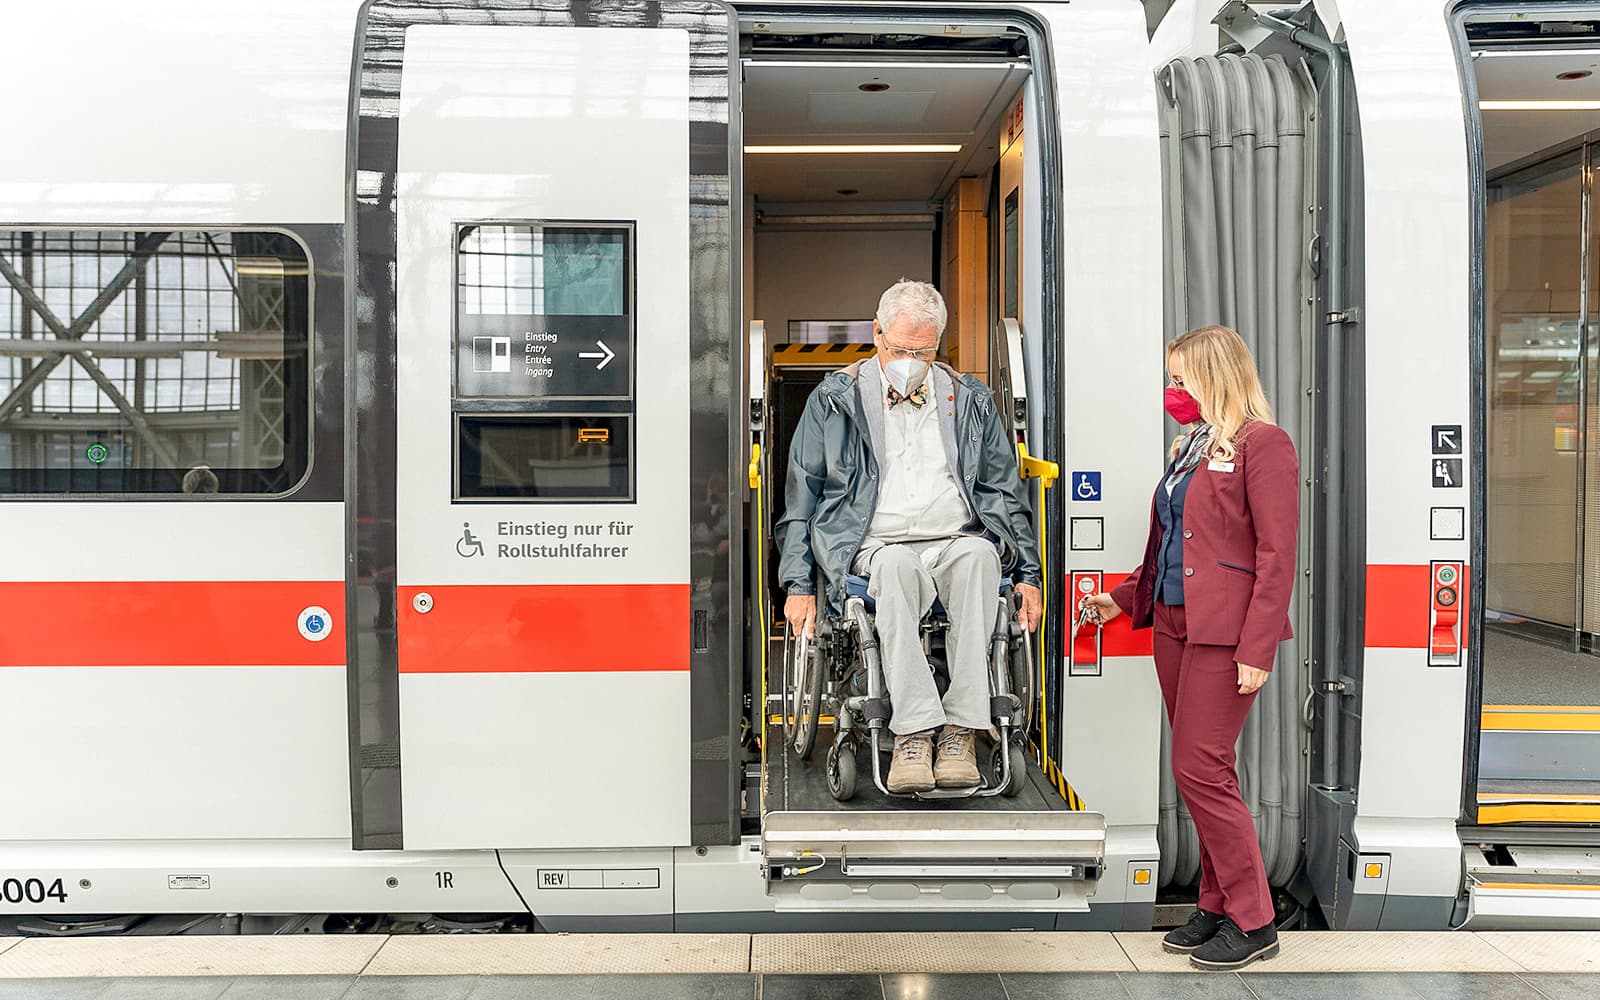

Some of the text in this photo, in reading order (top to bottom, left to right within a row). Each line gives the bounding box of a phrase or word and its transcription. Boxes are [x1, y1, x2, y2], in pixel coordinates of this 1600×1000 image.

[525, 331, 558, 344] Einstieg
[525, 343, 548, 354] Entry
[525, 355, 552, 365] Entrée
[525, 366, 554, 378] Ingang
[497, 521, 634, 539] Einstieg nur für
[497, 543, 629, 558] Rollstuhlfahrer
[435, 871, 454, 889] 1R
[543, 873, 564, 886] REV
[0, 878, 69, 903] 004
